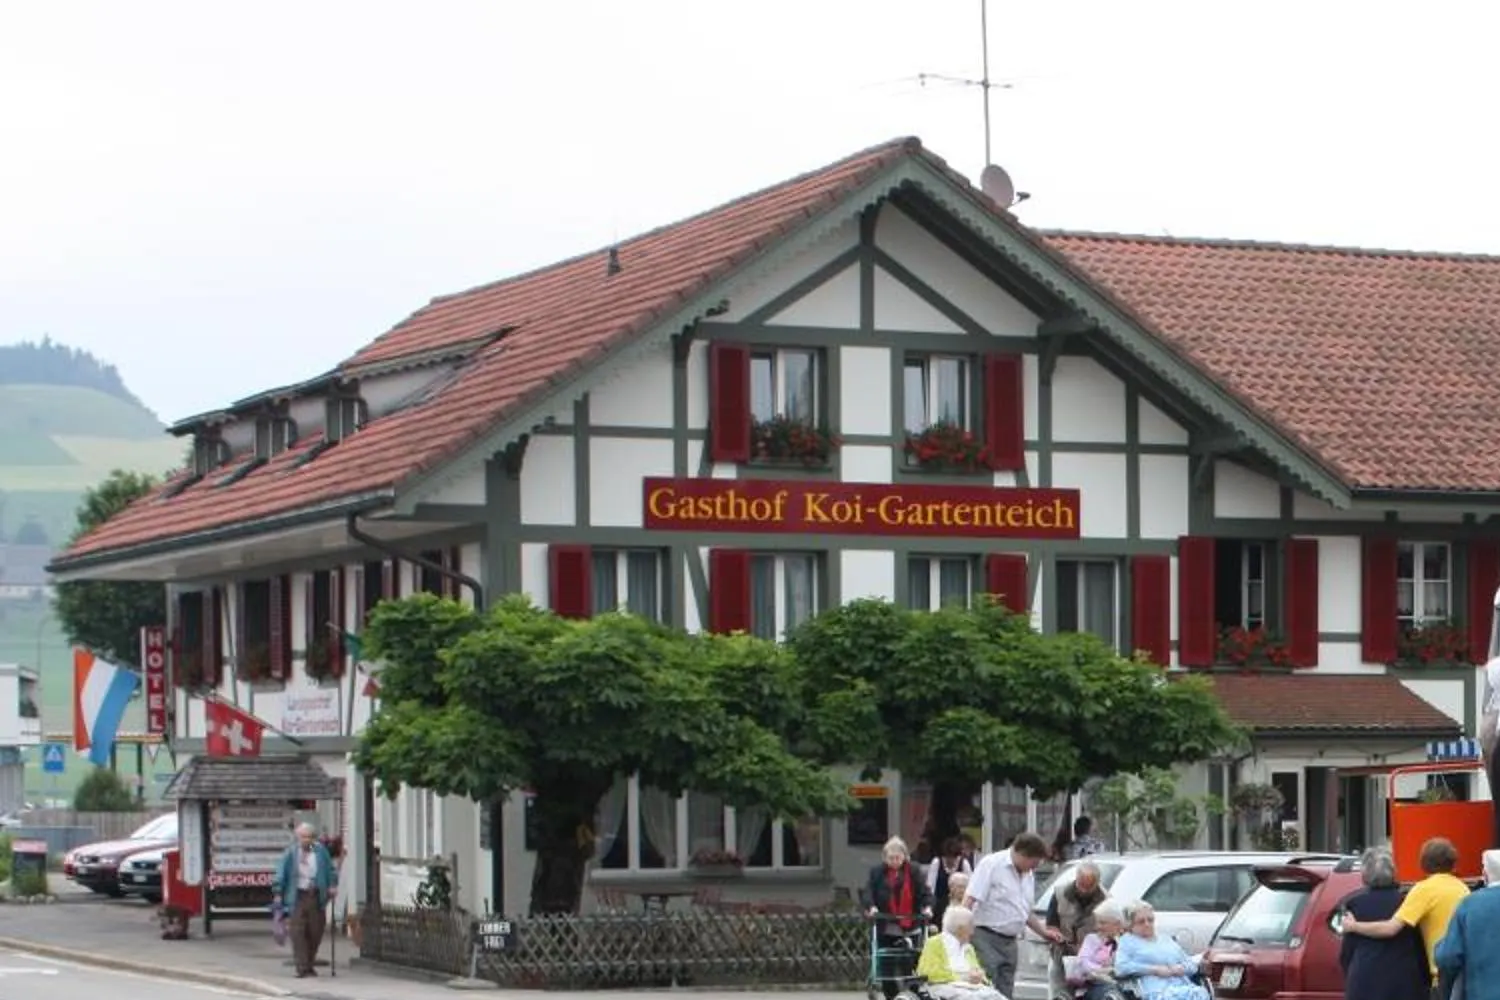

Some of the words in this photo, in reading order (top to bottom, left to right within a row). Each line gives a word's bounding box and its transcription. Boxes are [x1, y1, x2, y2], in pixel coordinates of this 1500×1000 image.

[649, 487, 787, 521] Gasthof
[804, 493, 1075, 529] Koi-Gartenteich
[147, 630, 165, 730] HOTEL
